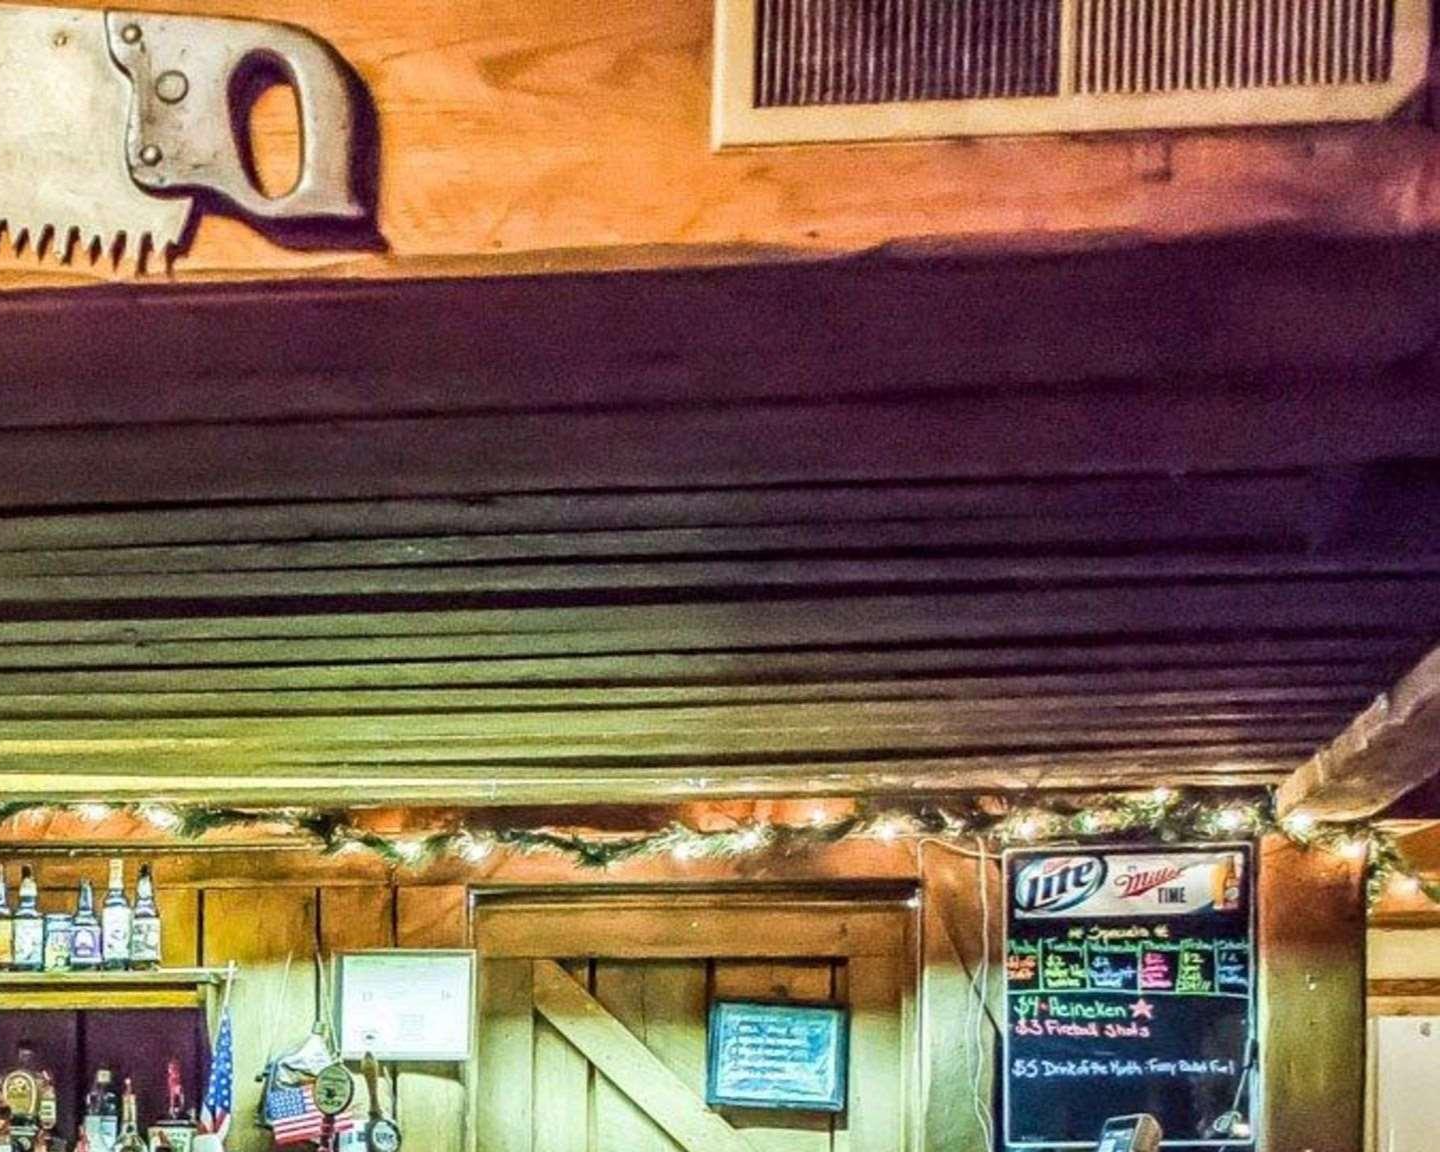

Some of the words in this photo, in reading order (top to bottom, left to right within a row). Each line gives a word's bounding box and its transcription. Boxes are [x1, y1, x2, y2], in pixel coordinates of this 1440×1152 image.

[1023, 861, 1094, 912] Lite
[1114, 866, 1185, 900] Miller
[1158, 886, 1187, 904] TIME
[1048, 996, 1127, 1018] Heineken
[1011, 1059, 1038, 1078] $5
